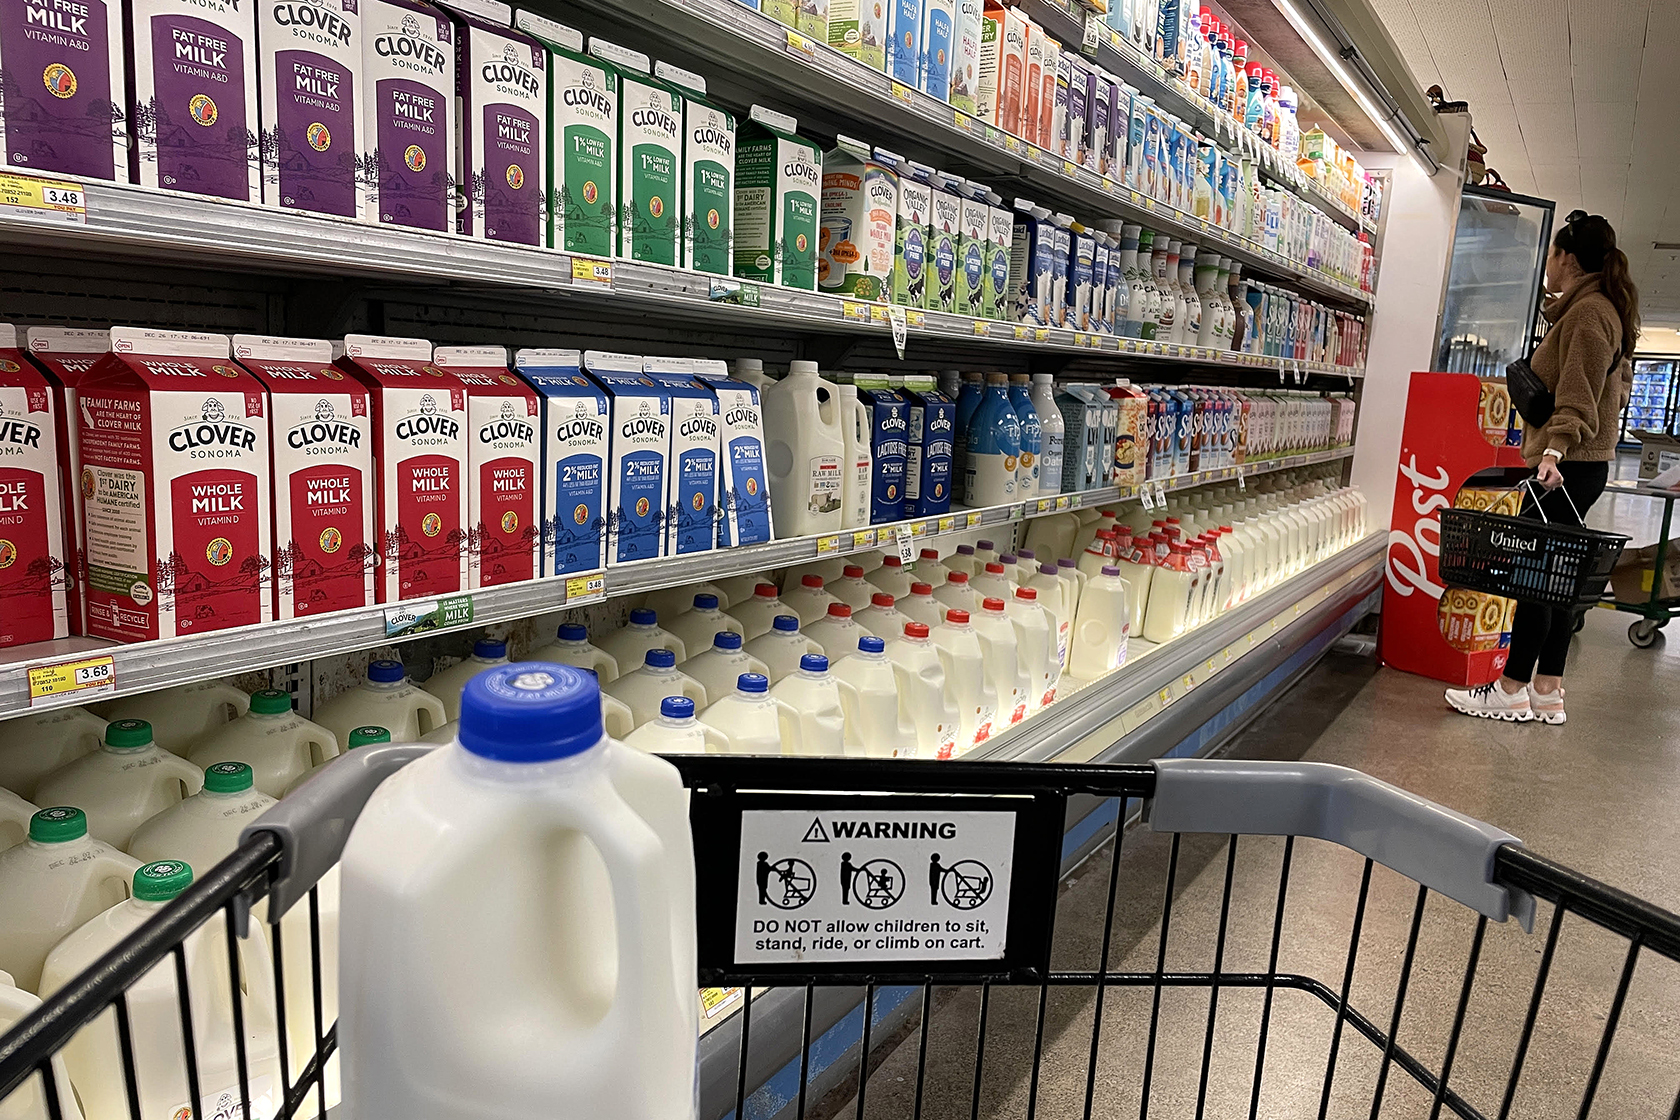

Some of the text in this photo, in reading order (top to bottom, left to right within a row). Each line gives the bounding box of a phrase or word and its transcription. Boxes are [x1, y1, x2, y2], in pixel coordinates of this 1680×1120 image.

[54, 0, 89, 17] FREE
[903, 9, 917, 21] HALF
[26, 5, 88, 36] MILK
[273, 4, 352, 48] CLOVER
[24, 29, 91, 51] VITAMIN A&D
[292, 27, 339, 48] SONOMA
[936, 28, 949, 39] HALF
[172, 29, 228, 53] FAT FREE
[175, 42, 227, 70] MILK
[374, 37, 446, 74] CLOVER
[172, 62, 229, 84] VITAMIN A&D
[293, 62, 340, 85] FAT FREE
[392, 58, 434, 76] SONOMA
[296, 76, 340, 100] MILK
[481, 65, 540, 99] CLOVER
[496, 84, 531, 101] SONOMA
[293, 94, 341, 112] VITAMIN A&D
[393, 91, 435, 109] FAT FREE
[563, 88, 612, 120] CLOVER
[395, 103, 434, 124] MILK
[575, 107, 604, 121] SONOMA
[393, 119, 436, 136] VITAMIN A&D
[497, 114, 531, 132] FAT FREE
[632, 110, 678, 139] CLOVER
[498, 124, 531, 144] MILK
[642, 127, 671, 140] SONOMA
[693, 126, 731, 155] CLOVER
[496, 141, 521, 153] VITAMIN
[573, 136, 586, 152] 1%
[586, 145, 605, 159] MILK
[641, 153, 653, 170] 1%
[652, 161, 671, 175] MILK
[700, 169, 711, 185] 1%
[784, 162, 819, 187] CLOVER
[710, 176, 726, 190] MILK
[49, 190, 79, 205] 3.48
[744, 193, 766, 201] DAIRY
[870, 185, 893, 203] CLOVER
[903, 187, 929, 205] ORGANIC
[790, 199, 800, 213] 1%
[799, 205, 813, 217] MILK
[905, 199, 927, 215] VALLEY
[935, 199, 958, 216] ORGANIC
[595, 266, 609, 276] 3.48
[743, 292, 759, 303] MILK
[140, 359, 197, 369] WHOLE
[259, 364, 307, 373] WHOLE
[370, 362, 413, 370] WHOLE
[147, 366, 207, 378] MILK
[267, 370, 318, 381] MILK
[377, 366, 421, 377] MILK
[460, 377, 499, 386] MILK
[87, 397, 141, 412] FAMILY FARMS
[132, 413, 141, 421] OF
[725, 409, 759, 427] CLOVER
[97, 419, 142, 431] CLOVER MILK
[396, 416, 460, 441] CLOVER
[479, 419, 534, 444] CLOVER
[557, 421, 604, 442] CLOVER
[622, 418, 666, 439] CLOVER
[680, 419, 717, 438] CLOVER
[881, 418, 907, 431] CLOVER
[930, 418, 952, 432] CLOVER
[168, 424, 257, 453] CLOVER
[288, 423, 361, 449] CLOVER
[411, 438, 449, 447] SONOMA
[568, 439, 597, 447] SONOMA
[305, 446, 349, 455] SONOMA
[493, 441, 525, 450] SONOMA
[734, 446, 745, 459] 2%
[190, 450, 242, 459] SONOMA
[744, 449, 760, 458] MILK
[626, 461, 640, 476] 2%
[639, 465, 660, 475] MILK
[684, 458, 697, 472] 2%
[695, 462, 713, 472] MILK
[125, 473, 137, 481] the
[412, 467, 449, 478] WHOLE
[493, 468, 525, 479] WHOLE
[562, 465, 578, 482] 2%
[576, 469, 599, 481] MILK
[812, 469, 842, 478] RAW MILK
[108, 479, 136, 492] DAIRY
[191, 483, 243, 497] WHOLE
[306, 477, 350, 489] WHOLE
[412, 477, 450, 492] MILK
[493, 478, 526, 492] MILK
[109, 491, 139, 501] AMERICAN
[307, 488, 351, 505] MILK
[416, 493, 447, 503] VITAMIN D
[496, 493, 523, 502] VITAMIN D
[118, 501, 141, 509] certified
[192, 495, 244, 514] MILK
[312, 506, 348, 517] VITAMIN D
[197, 515, 240, 526] VITAMIN D
[1385, 453, 1450, 600] Post
[1490, 530, 1538, 552] United
[589, 580, 602, 589] 3.48
[120, 613, 146, 625] RECYCLE
[390, 613, 417, 626] CLOVER
[445, 610, 470, 622] MILK
[81, 665, 109, 680] 3.68
[41, 685, 54, 693] 110
[831, 821, 957, 840] WARNING
[48, 859, 65, 870] DEC
[753, 919, 990, 935] DO NOT allow children to sit,
[755, 935, 985, 953] stand, ride, or climb on cart.
